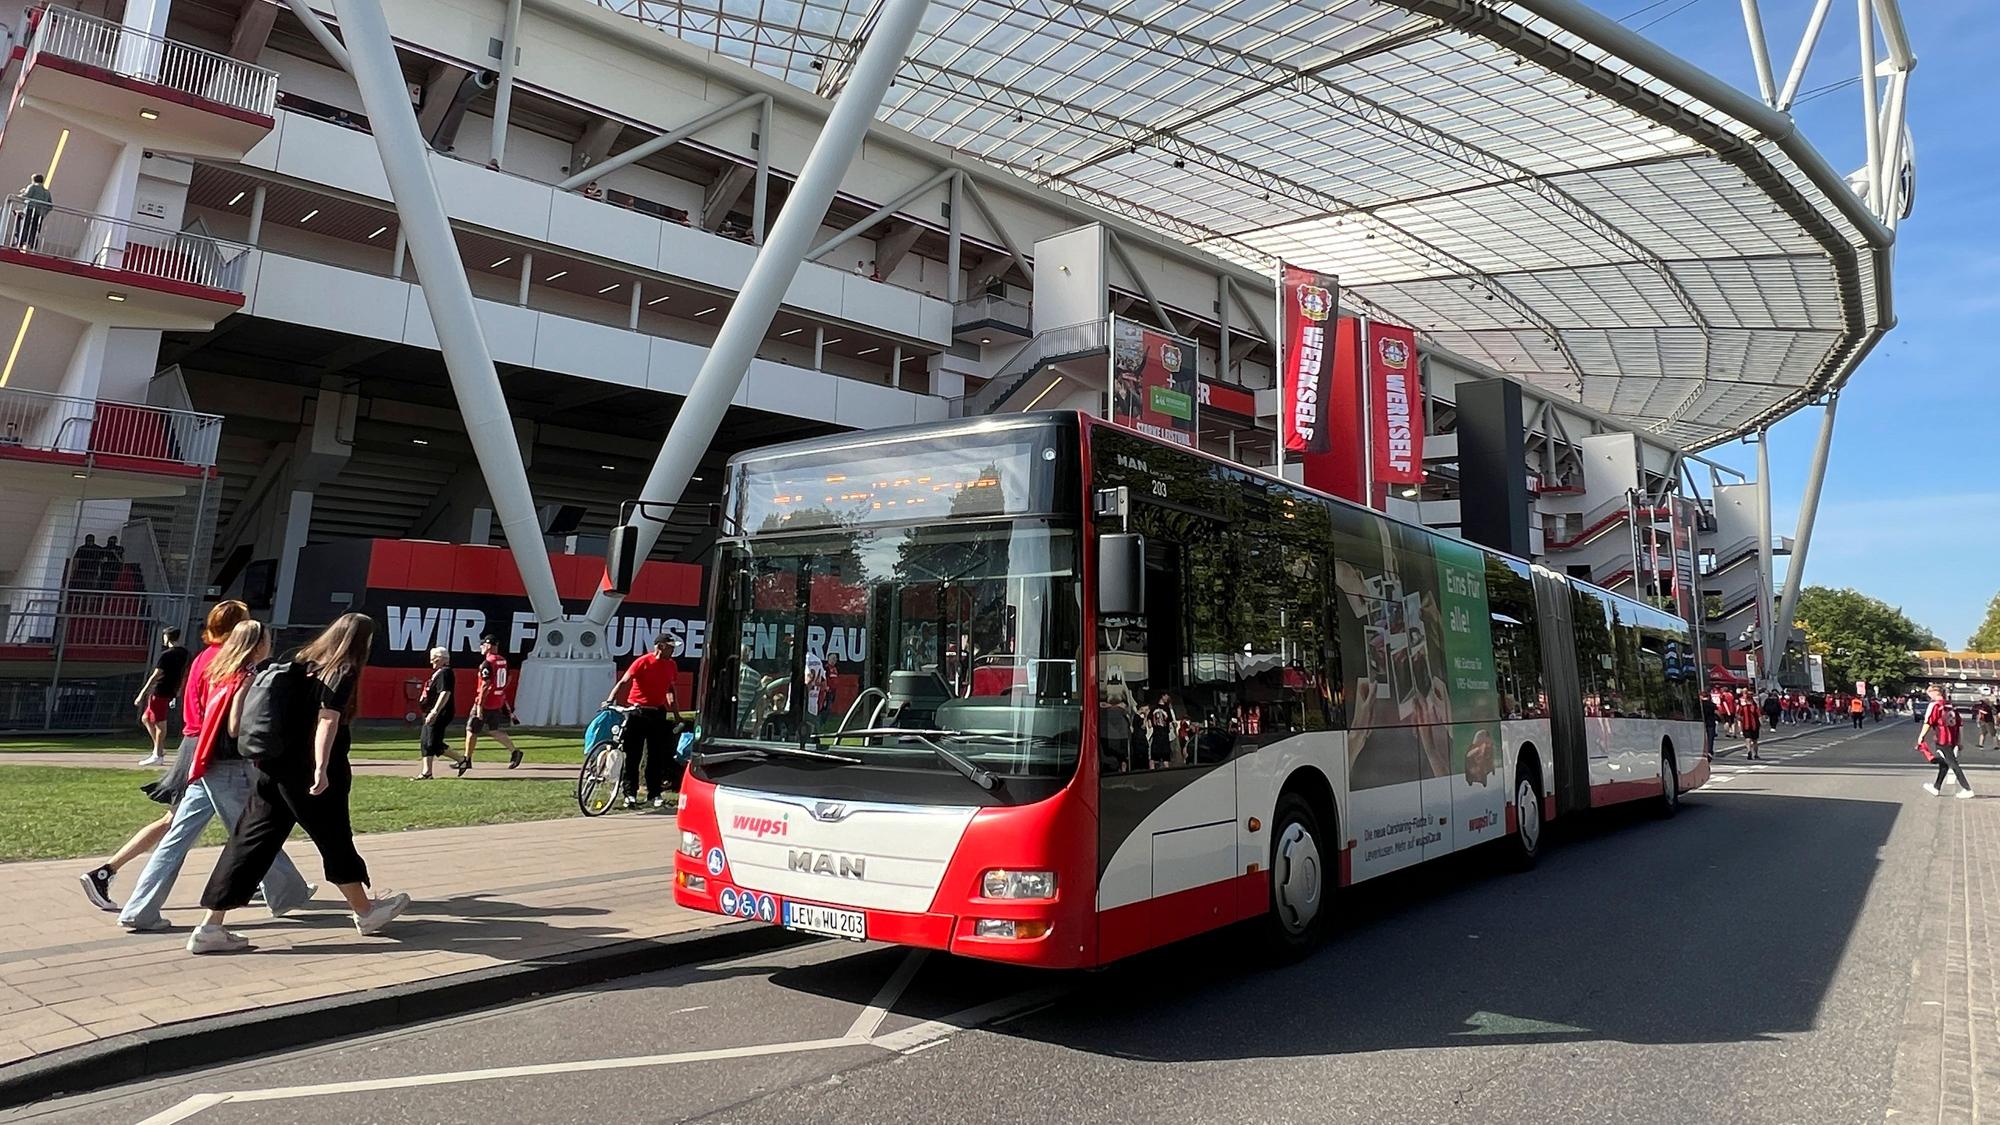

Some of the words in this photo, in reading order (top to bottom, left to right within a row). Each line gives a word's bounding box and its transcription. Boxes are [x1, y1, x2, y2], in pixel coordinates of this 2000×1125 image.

[1295, 326, 1324, 441] WERKSELF
[1386, 374, 1412, 472] WERKSELF
[1117, 454, 1148, 472] MAN
[1152, 480, 1167, 497] 203
[1446, 568, 1467, 596] Eins
[387, 606, 486, 652] WIR
[1450, 606, 1471, 633] alle!
[733, 813, 788, 838] wupsi
[788, 850, 865, 880] MAN
[792, 906, 814, 926] LEV
[822, 910, 838, 930] WU
[840, 913, 863, 934] 203
